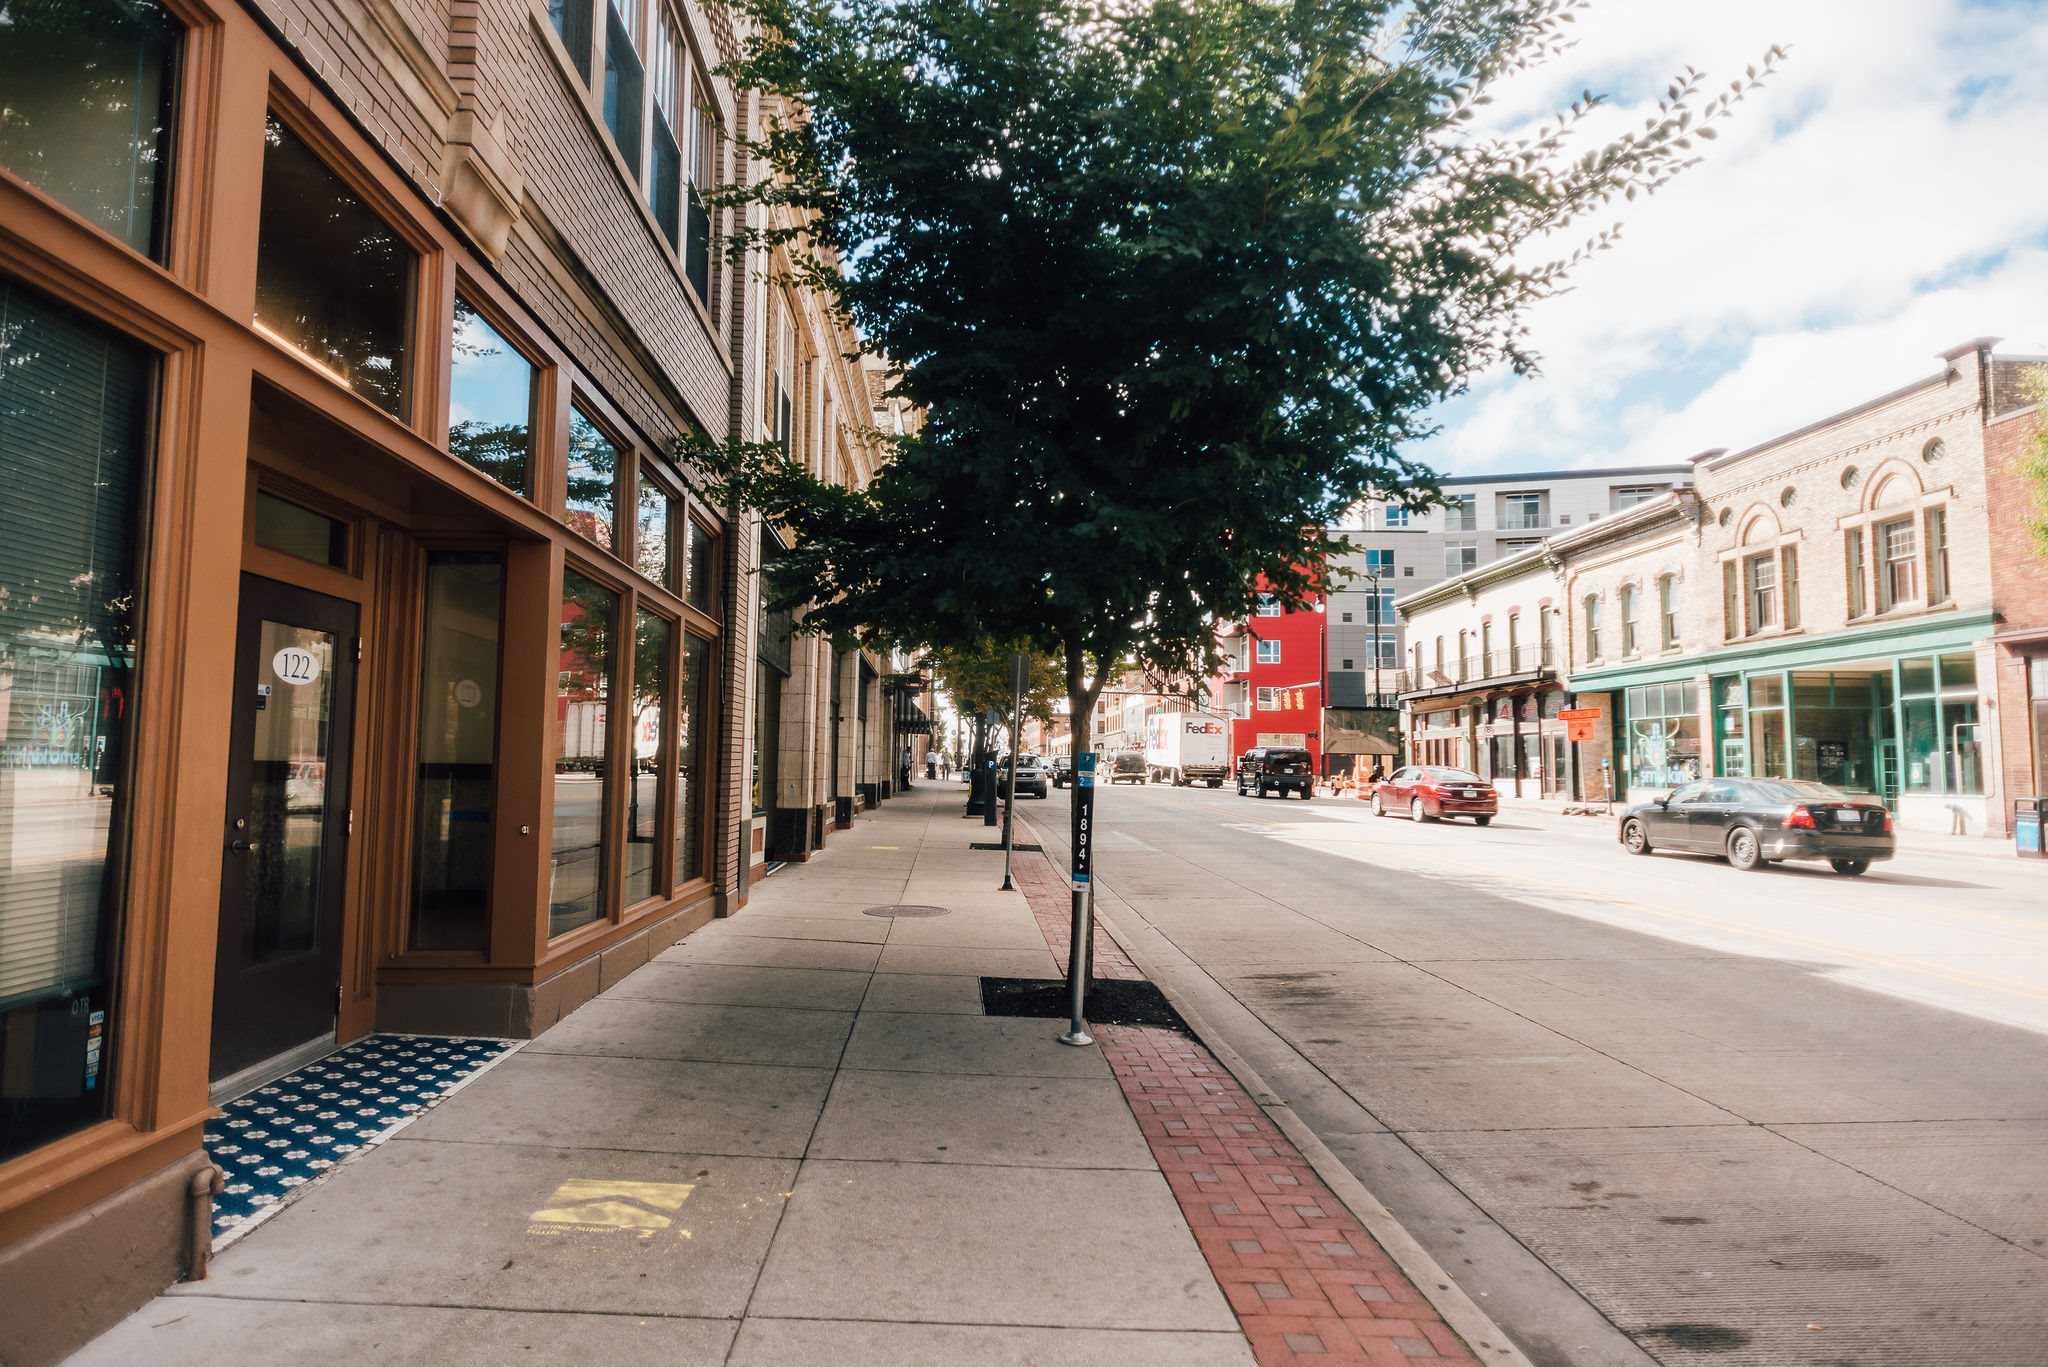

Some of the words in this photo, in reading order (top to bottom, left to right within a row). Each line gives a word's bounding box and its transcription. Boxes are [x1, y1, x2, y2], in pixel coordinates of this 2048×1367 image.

[283, 653, 309, 680] 122
[1185, 721, 1222, 735] FedEx
[1079, 777, 1085, 787] 2
[1079, 804, 1088, 860] 1894
